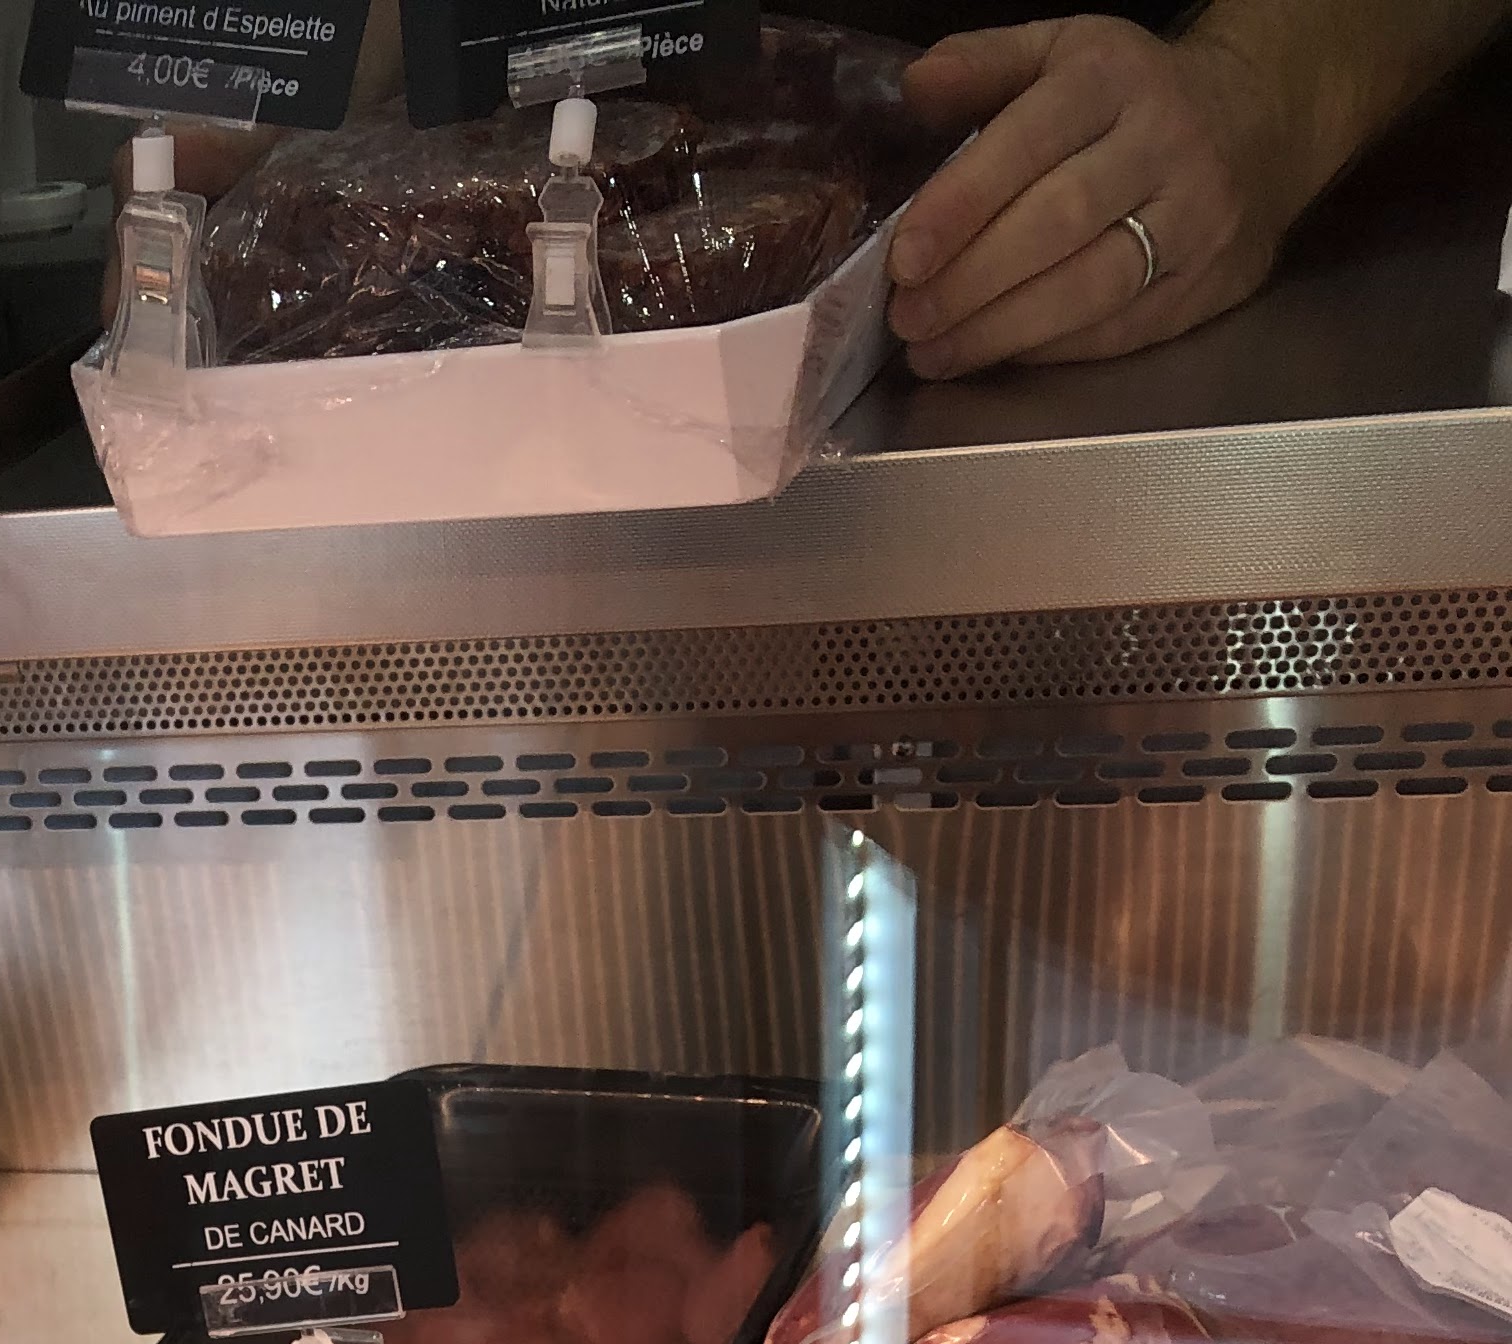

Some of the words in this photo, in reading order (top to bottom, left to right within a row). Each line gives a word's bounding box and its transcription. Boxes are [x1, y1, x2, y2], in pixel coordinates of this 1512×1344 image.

[116, 0, 196, 30] piment
[141, 1108, 308, 1160] FONDUE
[313, 1100, 373, 1140] DE
[183, 1156, 345, 1206] MAGRET
[204, 1223, 244, 1251] DE
[249, 1211, 366, 1247] CANARD
[217, 1264, 324, 1305] 25,90€
[328, 1272, 370, 1295] /Kg
